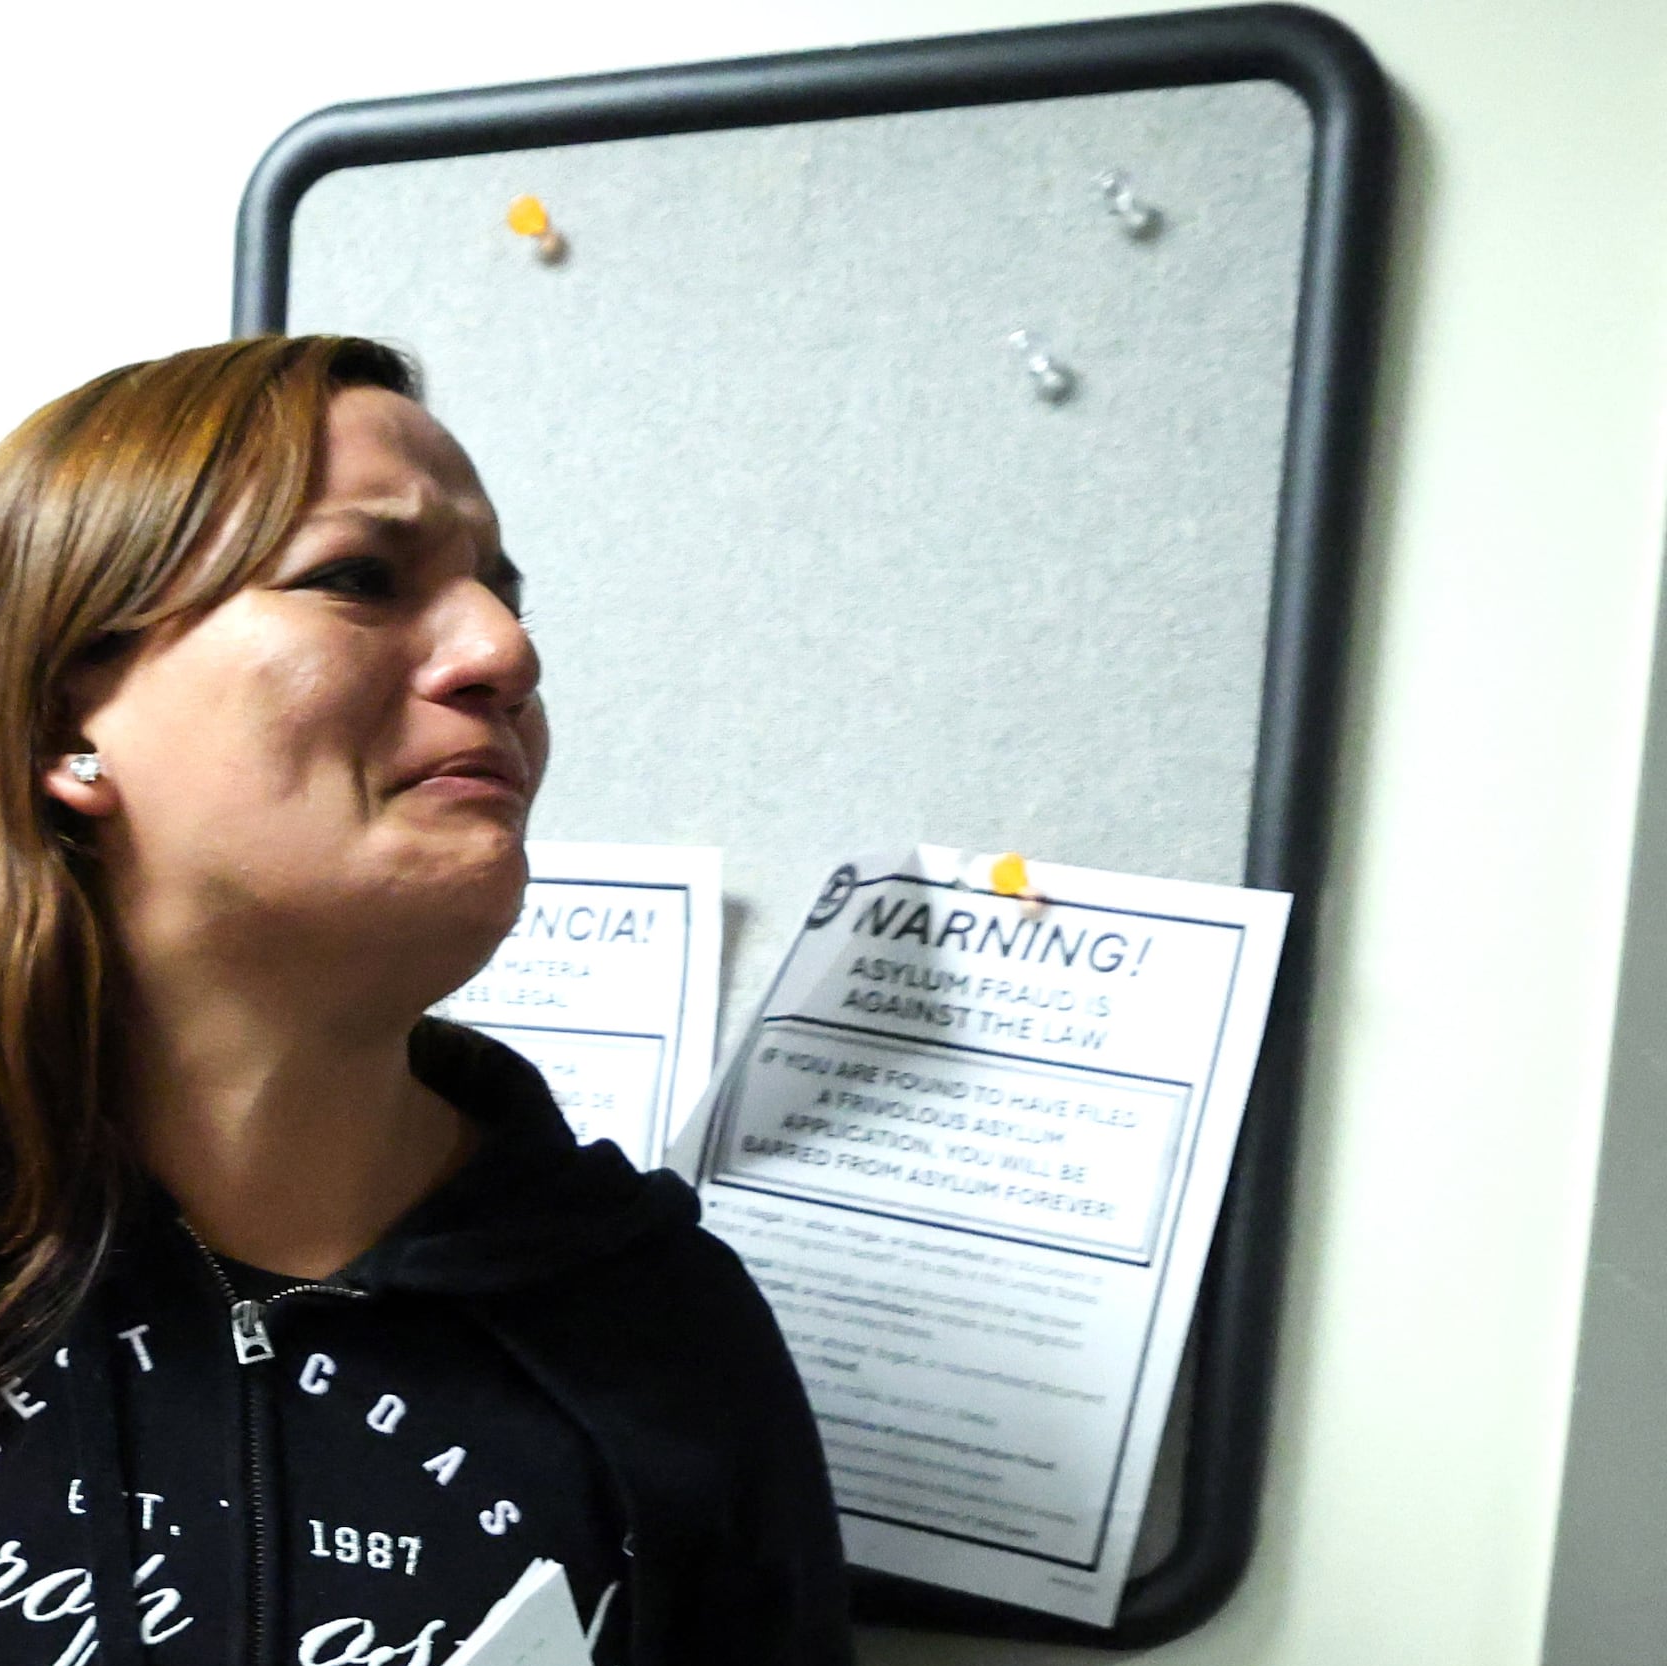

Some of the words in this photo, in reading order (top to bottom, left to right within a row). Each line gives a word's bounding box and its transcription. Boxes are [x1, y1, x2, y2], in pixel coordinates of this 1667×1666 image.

[849, 957, 968, 996] ASYLUM
[975, 976, 1076, 1017] FRAUD
[1085, 994, 1111, 1019] IS
[841, 988, 971, 1030] AGAINST
[978, 1009, 1035, 1041] THE
[1042, 1019, 1109, 1051] LAW
[835, 1061, 881, 1084] ARE
[884, 1069, 969, 1100] FOUND
[973, 1085, 1004, 1106] TO
[1007, 1091, 1071, 1118] HAVE
[837, 1091, 969, 1131] FRIVOLOUS
[971, 1117, 1067, 1145] ASYLUM
[834, 1152, 903, 1181] FROM
[906, 1167, 1001, 1198] ASYLUM
[945, 1143, 995, 1167] YOU
[298, 1352, 522, 1538] COAS
[67, 1478, 182, 1537] ET.
[308, 1518, 423, 1577] 1987
